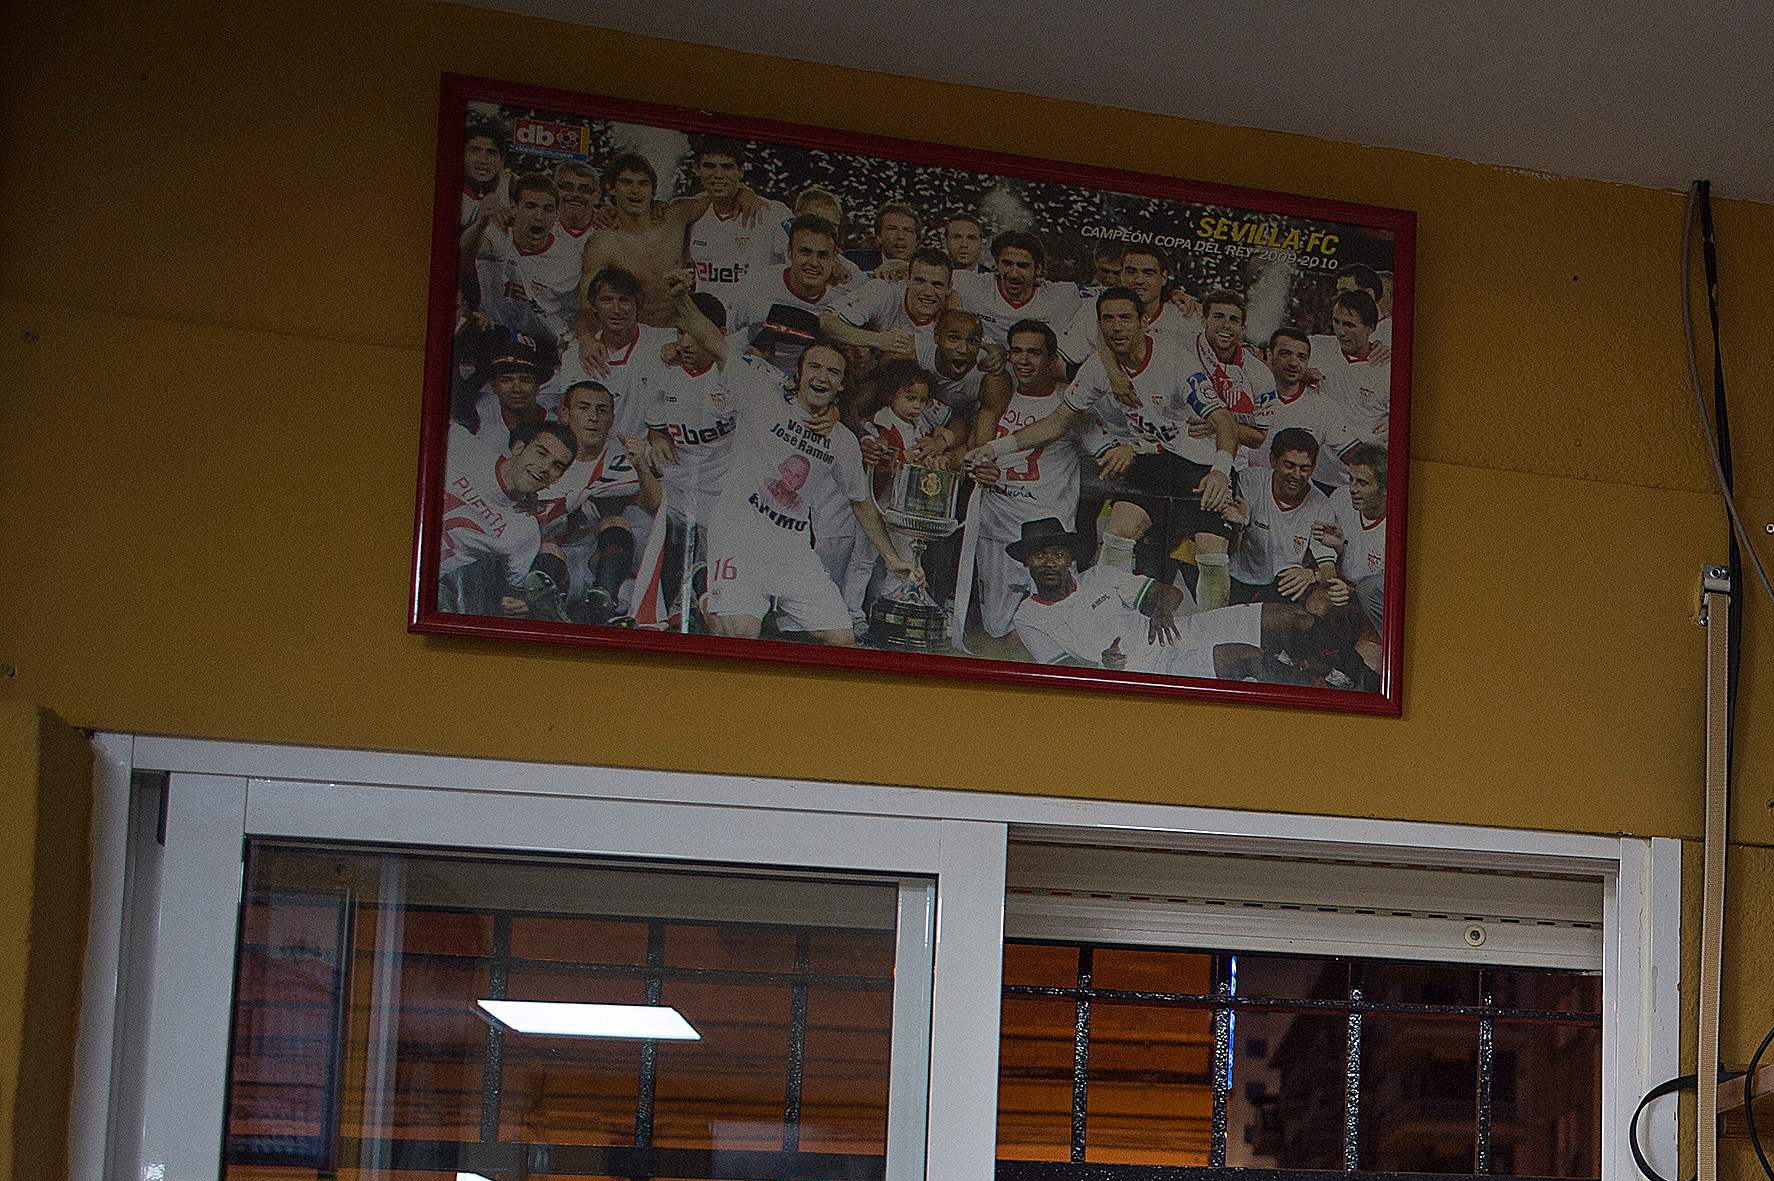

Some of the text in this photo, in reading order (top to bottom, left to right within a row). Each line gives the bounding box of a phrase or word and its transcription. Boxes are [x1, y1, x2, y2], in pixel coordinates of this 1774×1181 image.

[1081, 225, 1153, 245] CAMPEÓN
[1154, 235, 1192, 251] COPA
[1194, 241, 1222, 256] DEL
[1225, 245, 1254, 259] REY
[1197, 217, 1340, 256] SEVILLA FC
